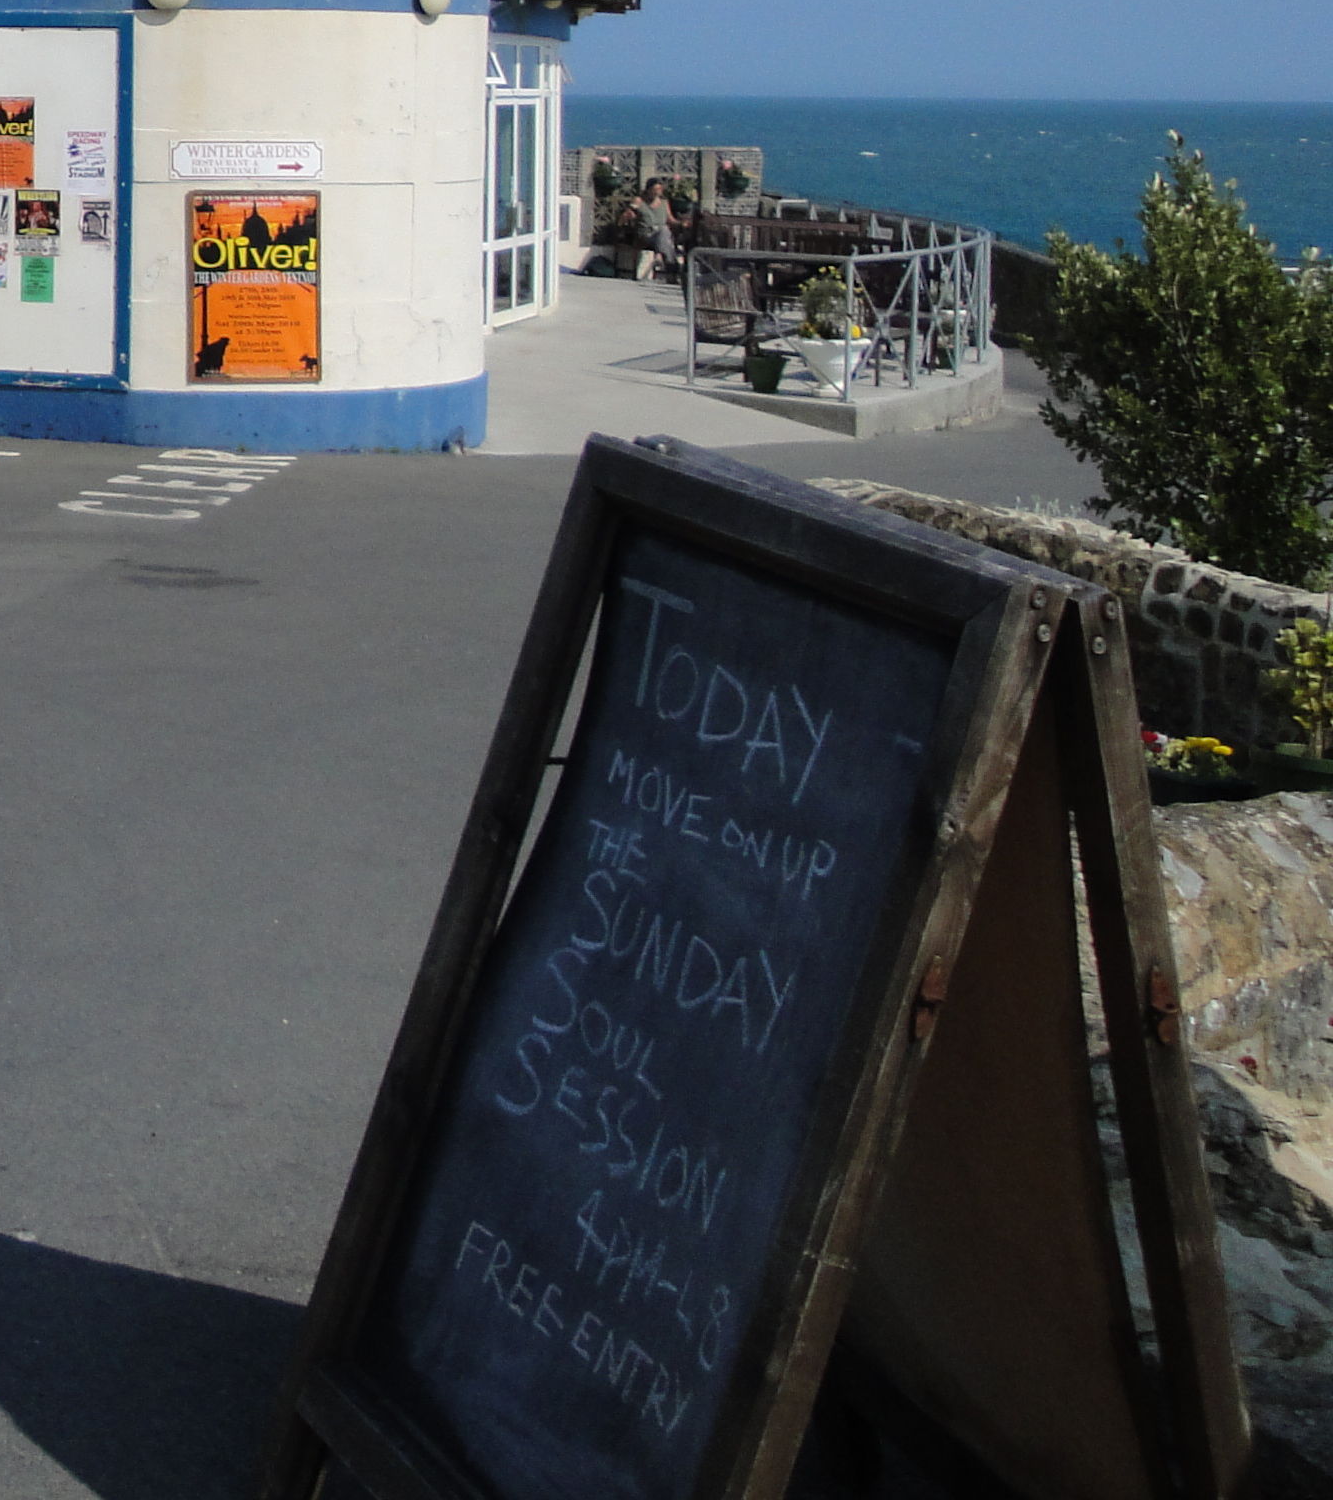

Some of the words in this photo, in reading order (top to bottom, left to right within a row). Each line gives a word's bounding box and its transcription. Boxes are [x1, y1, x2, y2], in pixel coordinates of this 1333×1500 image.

[187, 144, 244, 158] WINTER
[245, 144, 311, 158] GARDENS
[193, 236, 317, 271] Oliver!
[58, 449, 299, 519] CLEAR
[619, 576, 834, 805] TODAY
[586, 818, 648, 886] THE
[607, 748, 713, 843] MOVE
[720, 817, 774, 869] ON
[781, 832, 837, 902] UP
[532, 946, 663, 1100] SOUL
[570, 869, 800, 1055] SUNDAY
[494, 1033, 727, 1236] SESSION
[454, 1219, 565, 1338] FREE
[569, 1310, 696, 1435] ENTRY
